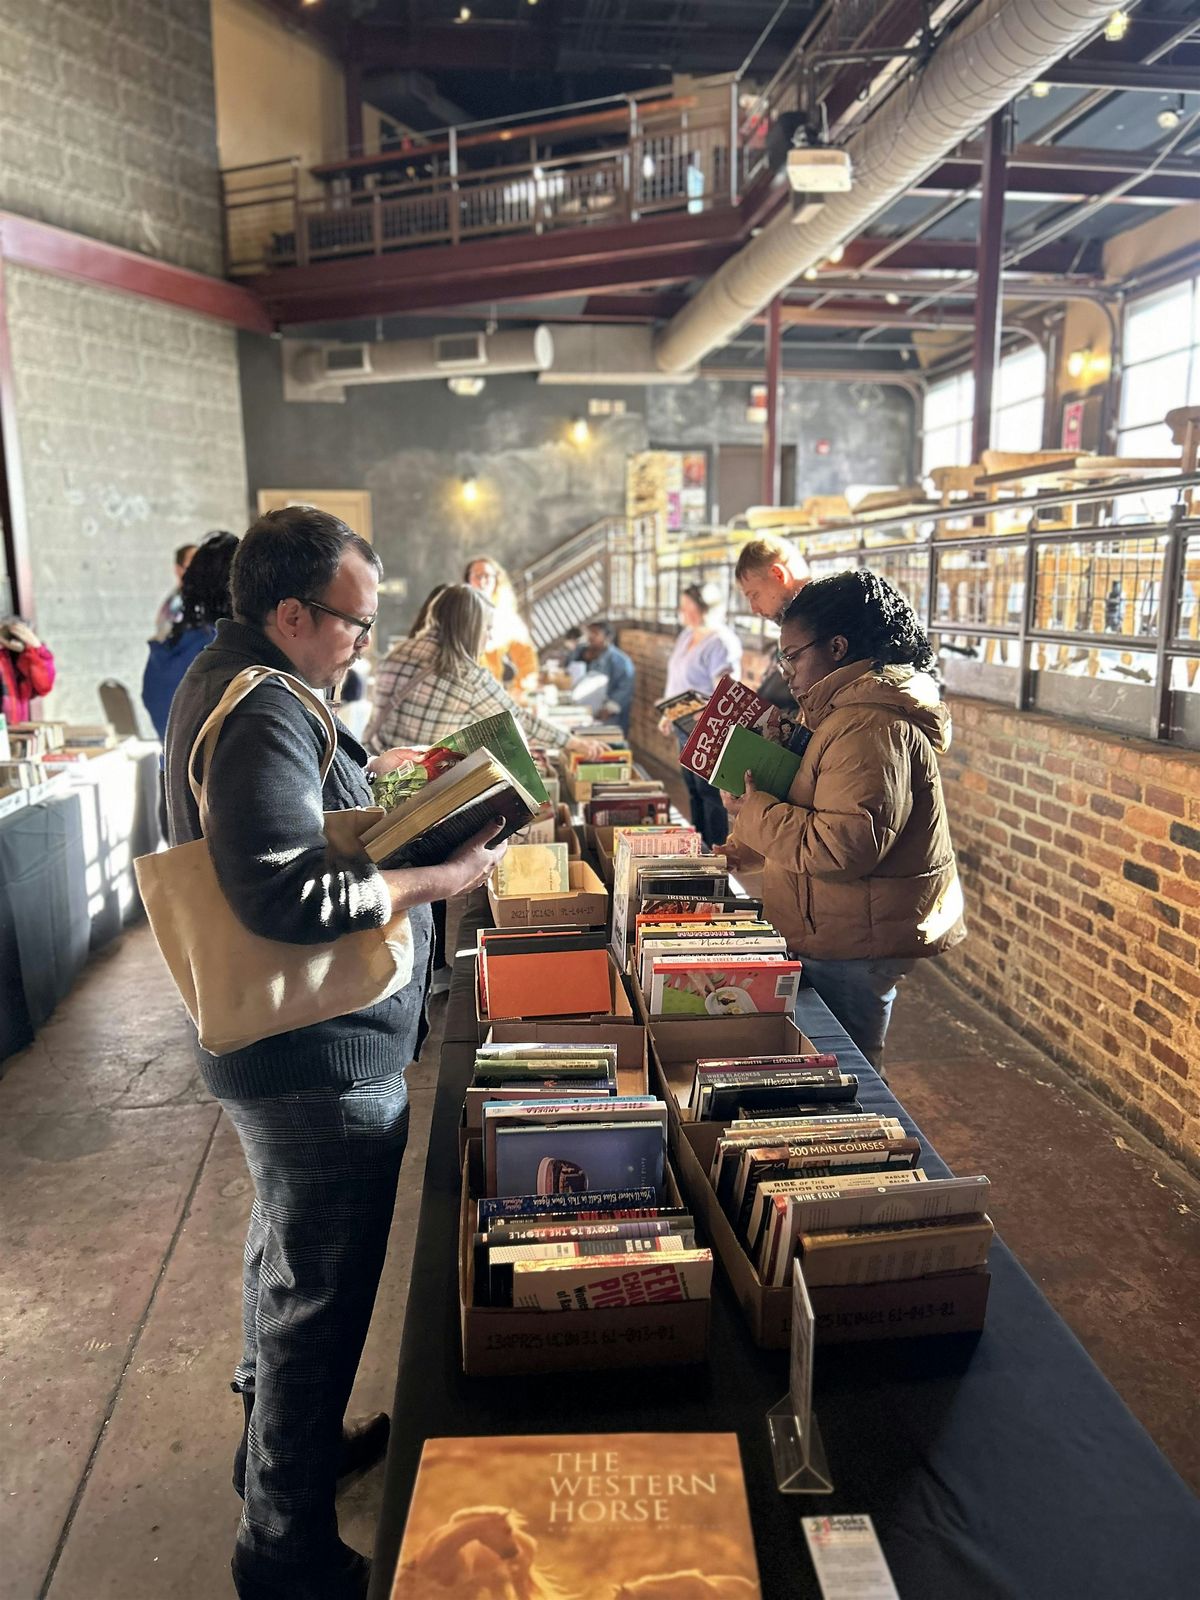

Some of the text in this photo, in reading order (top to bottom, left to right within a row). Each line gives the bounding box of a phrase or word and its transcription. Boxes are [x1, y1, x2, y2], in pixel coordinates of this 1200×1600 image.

[691, 682, 745, 771] GRACE
[788, 1141, 885, 1157] 500 MAIN COURSES
[603, 1192, 617, 1203] Blue
[618, 1191, 634, 1202] Never
[767, 1186, 813, 1194] WARRIOR
[795, 1191, 840, 1202] WINE FOLLY
[532, 1194, 550, 1207] Again
[551, 1196, 567, 1206] Town
[567, 1196, 580, 1205] This
[588, 1194, 602, 1204] Ball
[508, 1224, 619, 1239] OKOYE TO THE PEOPLE
[621, 1271, 645, 1307] CHAU
[641, 1263, 683, 1303] FEM
[573, 1284, 588, 1309] Wome
[551, 1451, 620, 1473] THE
[549, 1473, 718, 1497] WESTERN
[548, 1498, 671, 1523] HORSE
